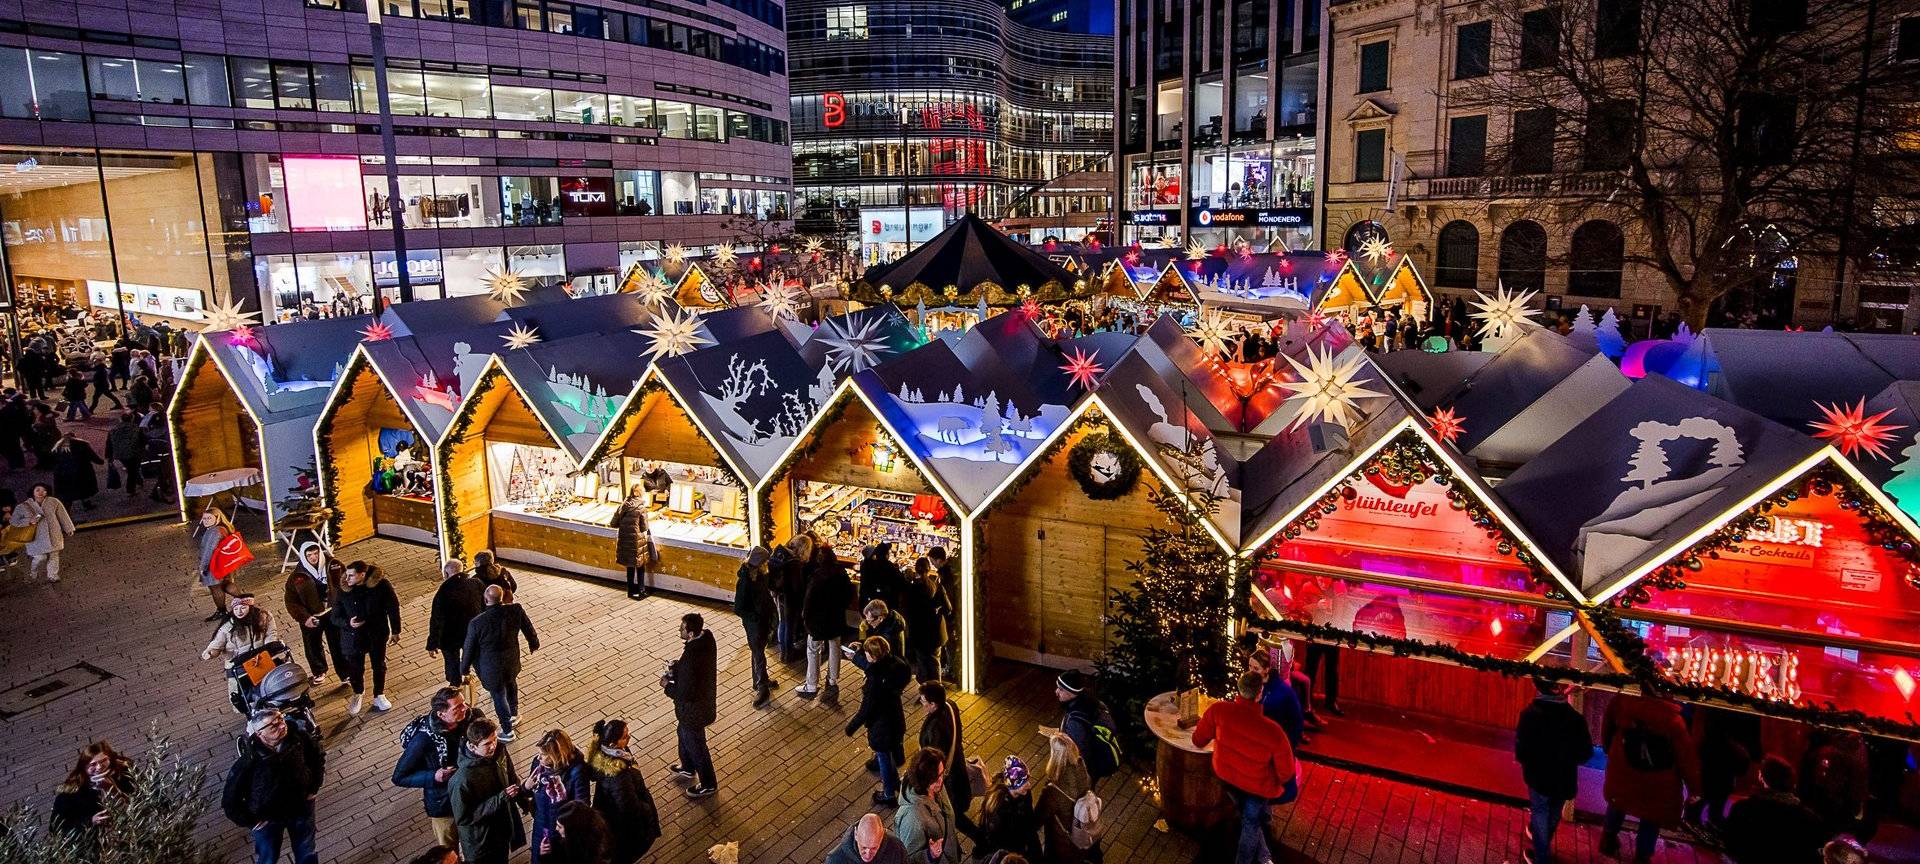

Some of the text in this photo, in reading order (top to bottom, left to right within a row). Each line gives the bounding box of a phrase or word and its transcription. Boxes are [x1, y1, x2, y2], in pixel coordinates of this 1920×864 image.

[569, 192, 606, 202] TUMI
[1211, 212, 1245, 221] vodafone
[377, 259, 438, 273] JOOP!
